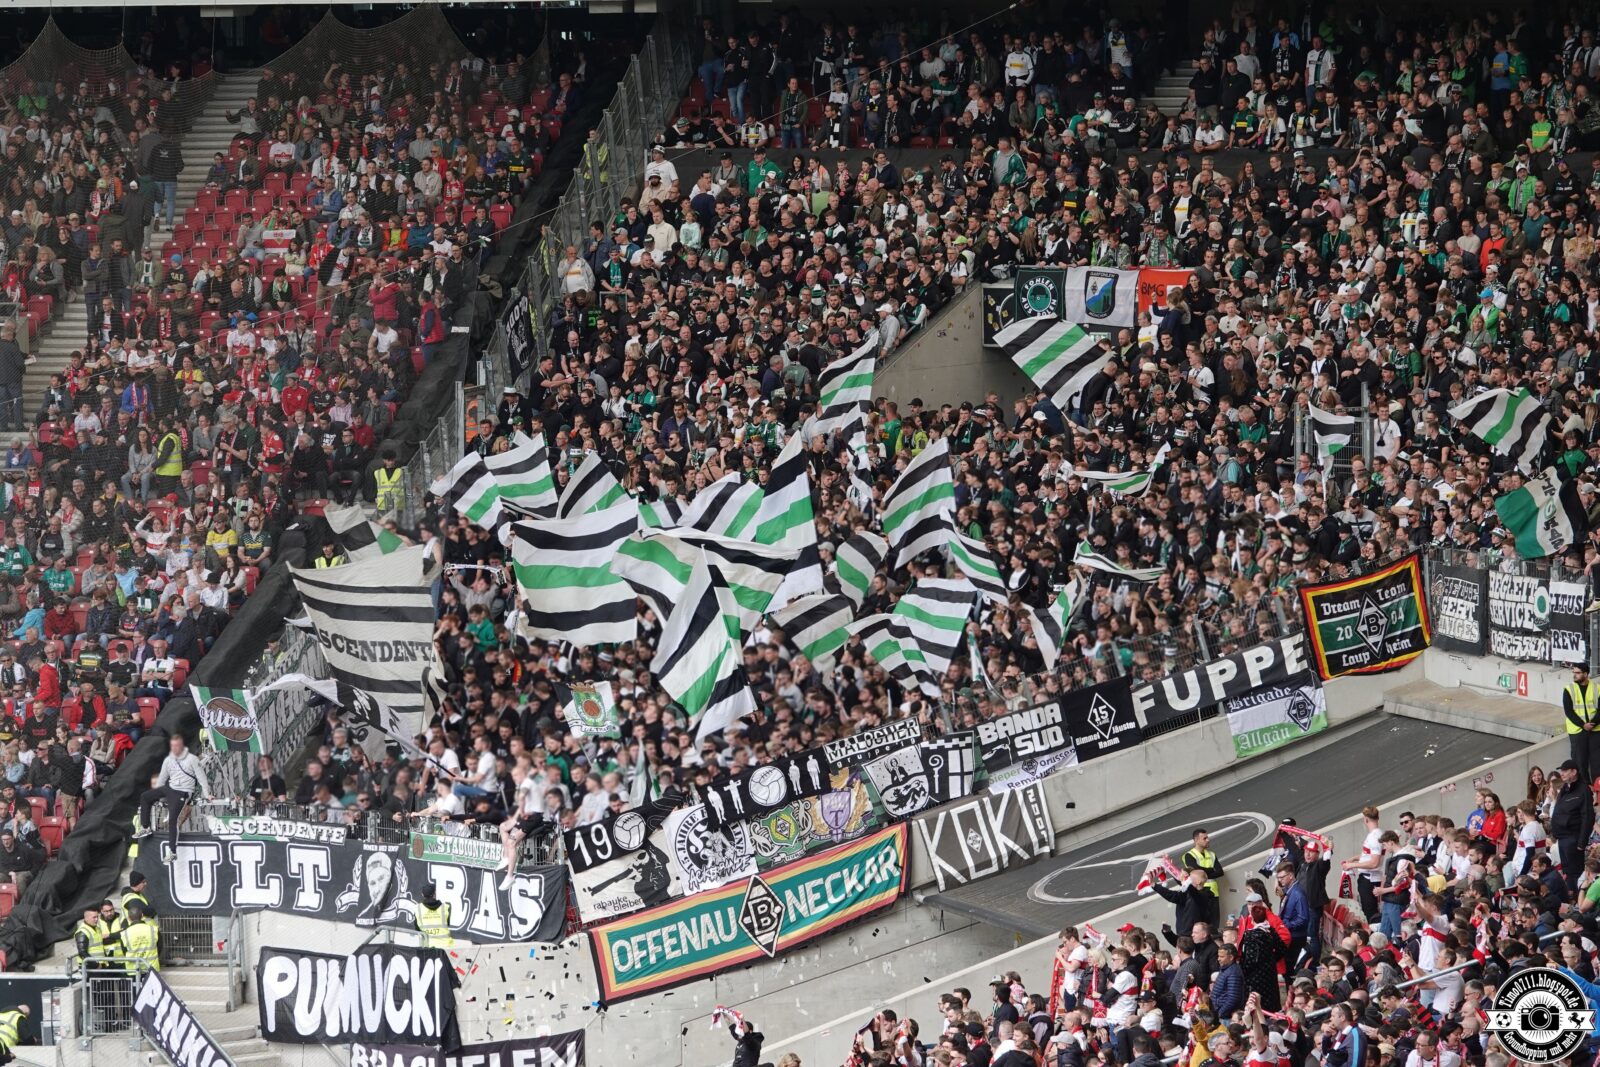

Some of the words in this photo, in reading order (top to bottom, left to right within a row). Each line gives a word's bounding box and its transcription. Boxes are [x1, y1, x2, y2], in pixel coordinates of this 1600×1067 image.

[1024, 277, 1054, 290] FOHLEN
[1141, 281, 1165, 298] BMG
[1022, 296, 1033, 314] AUS
[1320, 599, 1361, 616] Dream
[1376, 582, 1407, 601] Team
[1550, 592, 1584, 616] ITUS
[1335, 625, 1353, 642] 20
[1390, 607, 1405, 625] 04
[1489, 599, 1536, 631] SERVICE
[318, 628, 437, 663] SCENDENT
[1342, 650, 1371, 667] Laup
[1385, 637, 1412, 655] heim
[1552, 629, 1583, 652] REW
[1131, 632, 1309, 730] FUPPE
[1519, 673, 1526, 694] 4
[1092, 704, 1109, 722] 15
[1226, 686, 1292, 712] Brigade
[199, 704, 259, 731] Ultras
[977, 702, 1063, 746] BANDA
[825, 716, 919, 762] MALOCHER
[1014, 725, 1065, 757] SUD
[1237, 725, 1290, 751] Allgäu
[210, 817, 346, 846] ASCENDENTE
[160, 841, 332, 912] ULT
[593, 896, 628, 911] rabauke
[611, 906, 738, 973] OFFENAU
[784, 845, 901, 922] NECKAR
[134, 970, 232, 1067] PINK
